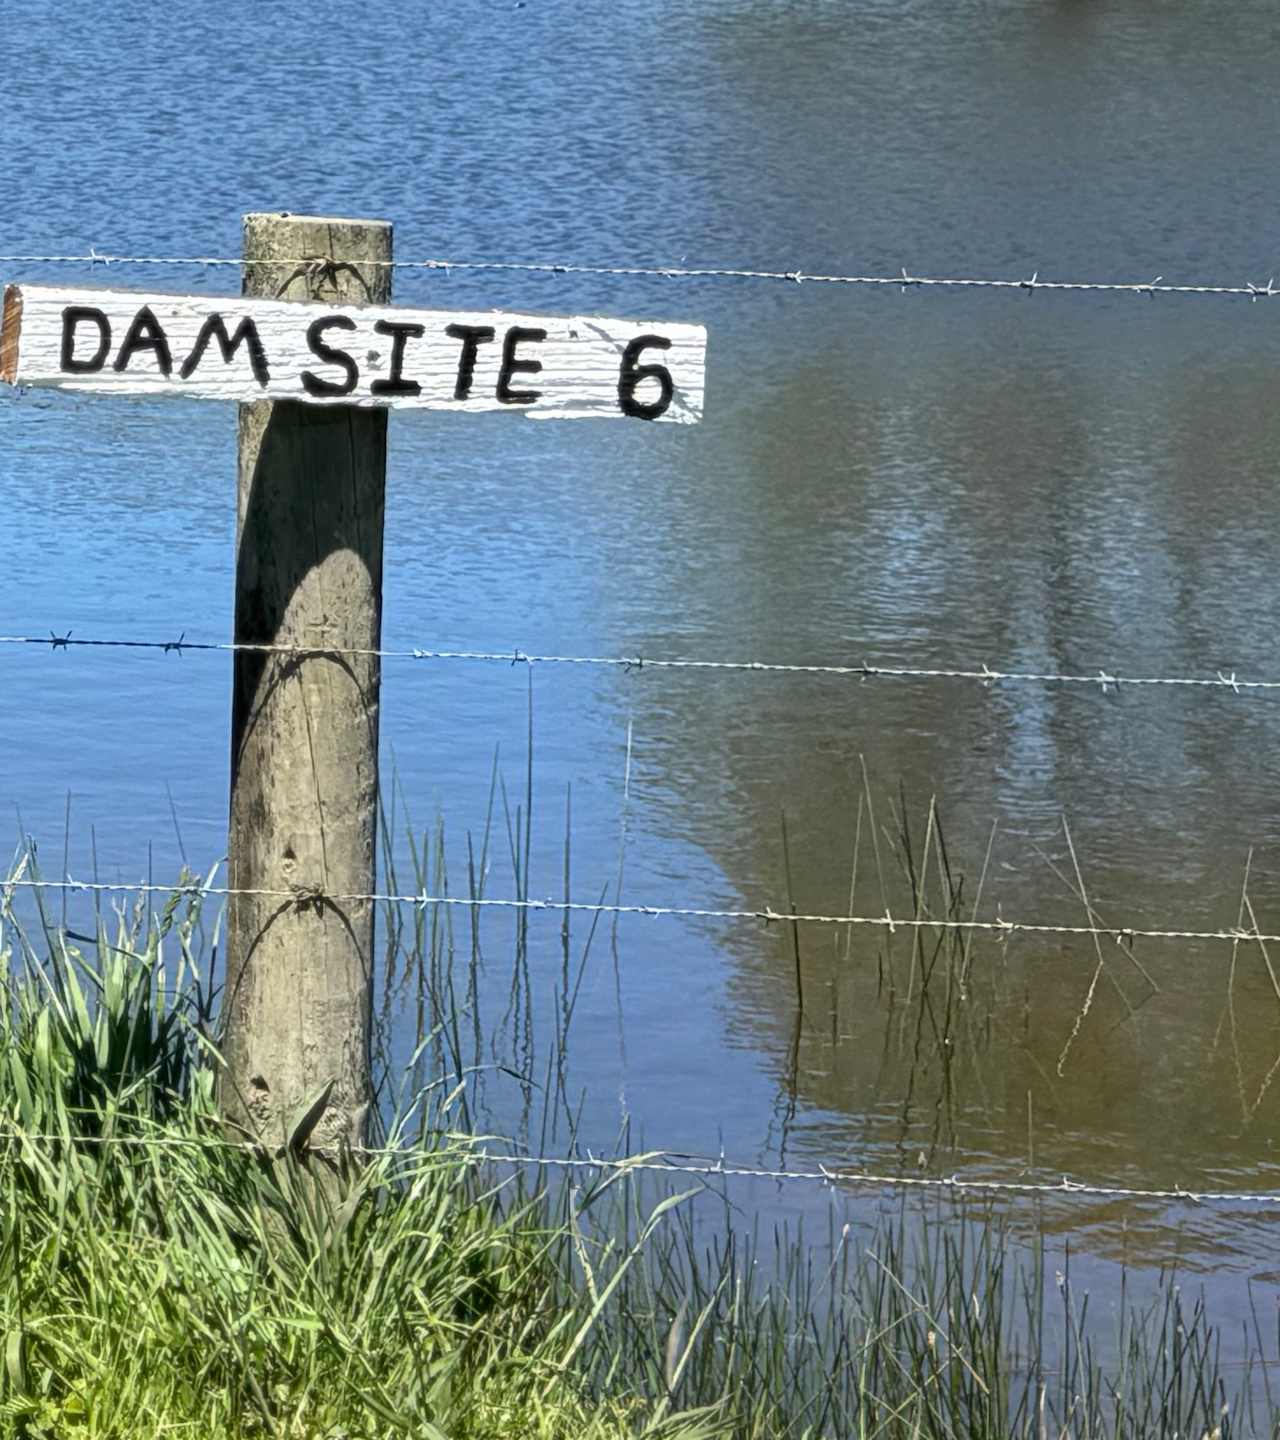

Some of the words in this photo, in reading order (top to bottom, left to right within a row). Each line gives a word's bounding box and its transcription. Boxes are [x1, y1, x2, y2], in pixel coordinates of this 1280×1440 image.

[60, 306, 269, 388] DAM
[300, 314, 548, 403] SITE
[617, 334, 673, 421] 6
